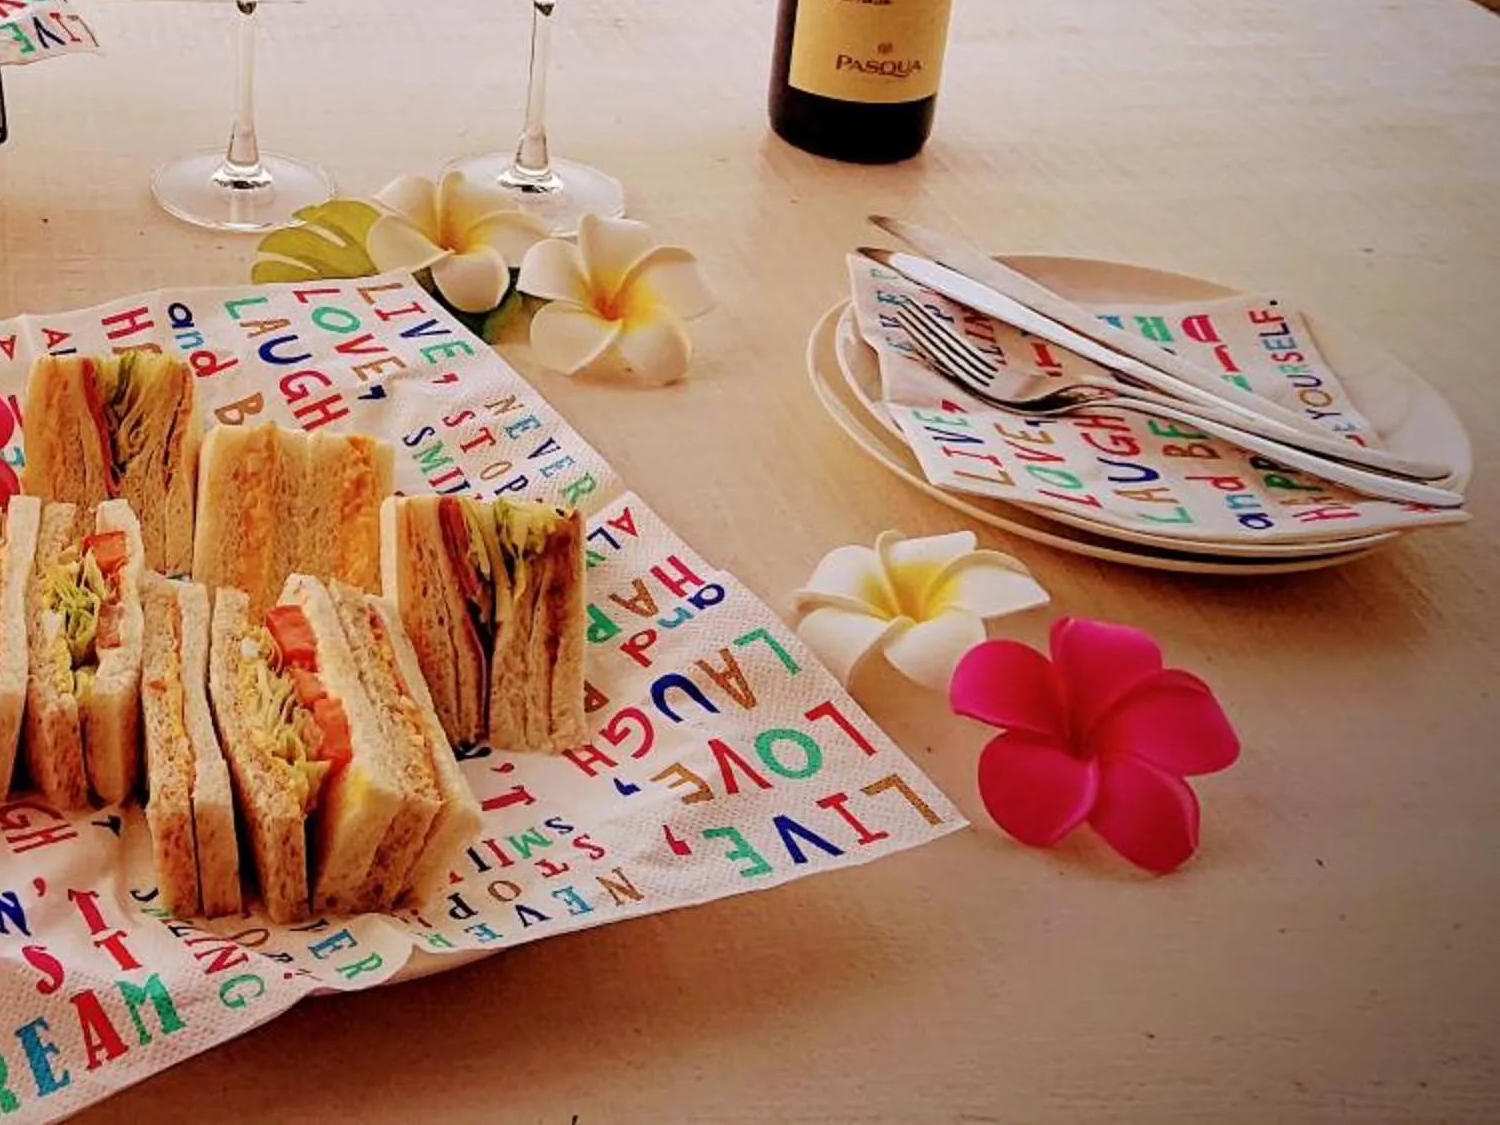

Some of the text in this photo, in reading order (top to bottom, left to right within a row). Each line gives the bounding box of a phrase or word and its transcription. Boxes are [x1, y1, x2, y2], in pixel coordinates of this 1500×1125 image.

[836, 54, 921, 78] PASQUA
[167, 302, 240, 378] and
[224, 295, 351, 433] LAUGH
[293, 286, 408, 401] LOVE,
[357, 281, 476, 386] LIVE,
[1246, 300, 1341, 420] YOURSELF.
[483, 394, 597, 506] NEVER
[1071, 413, 1193, 524] LAUGH
[1184, 476, 1274, 530] and
[619, 582, 726, 669] and
[562, 627, 802, 777] LAUGH
[612, 700, 878, 805] LOVE,
[660, 772, 947, 880] LIVE,
